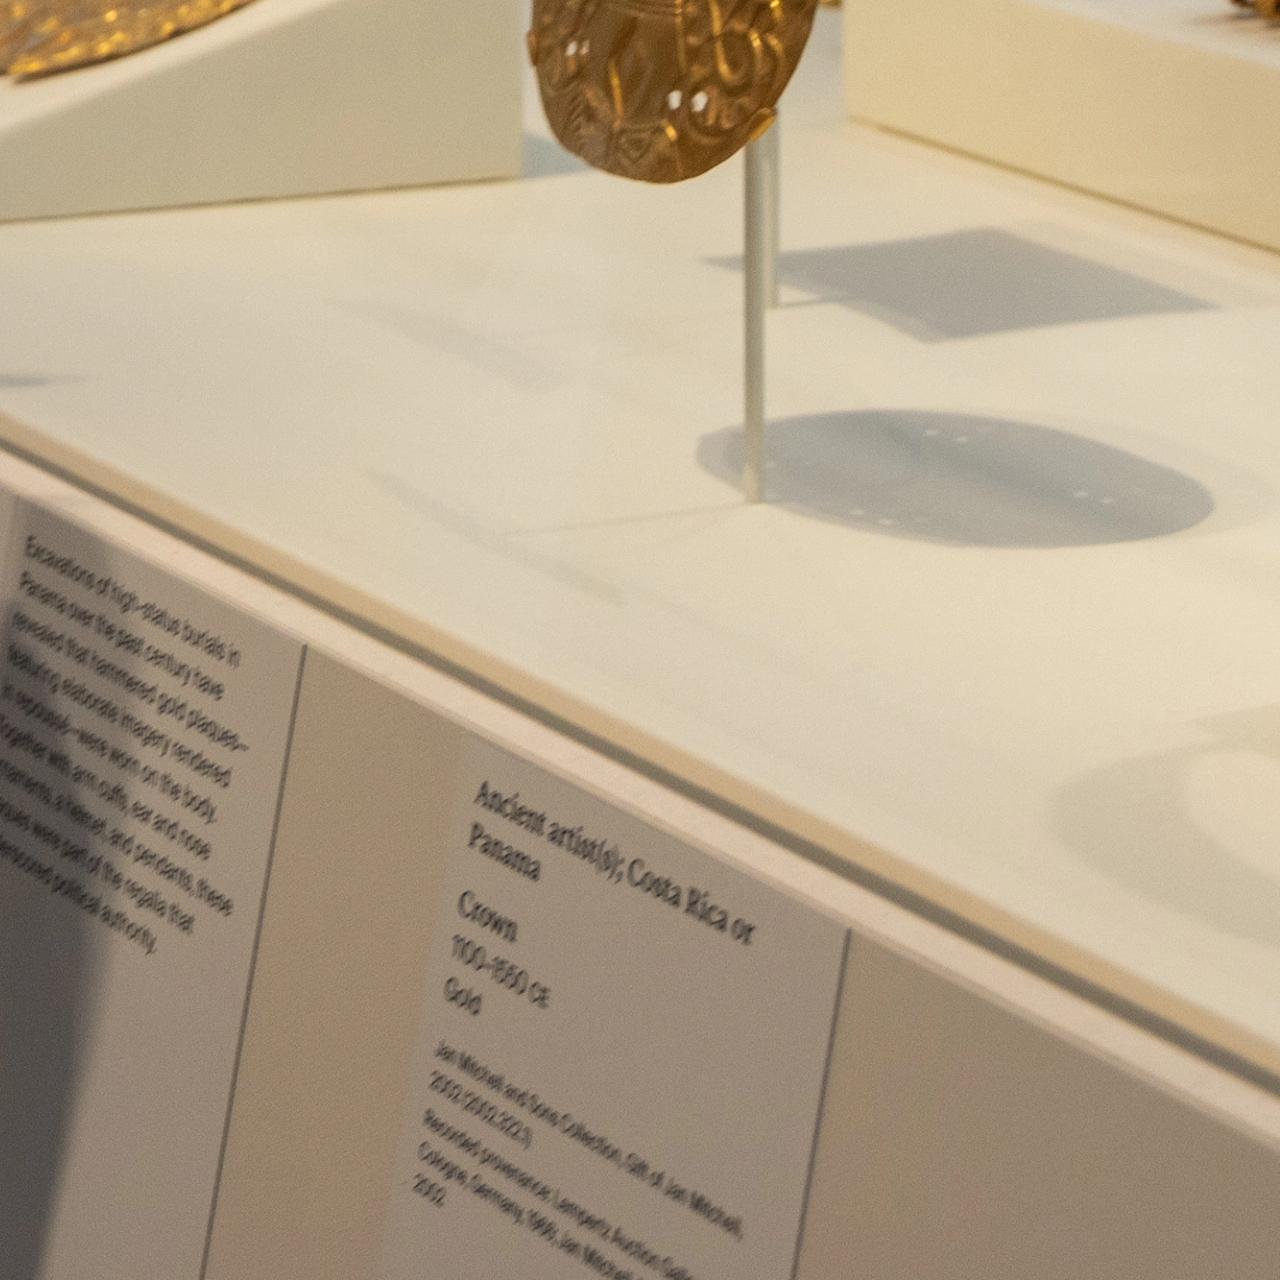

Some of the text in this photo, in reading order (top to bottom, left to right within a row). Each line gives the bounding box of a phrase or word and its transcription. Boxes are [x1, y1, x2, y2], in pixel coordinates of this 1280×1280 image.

[24, 535, 95, 590] Excavations
[19, 571, 69, 614] Panama
[468, 822, 541, 882] Panama
[474, 780, 547, 836] Ancient
[627, 858, 682, 908] Costa
[684, 887, 729, 933] Rica
[730, 918, 756, 946] or
[458, 890, 518, 944] Crown
[444, 977, 482, 1016] Gold
